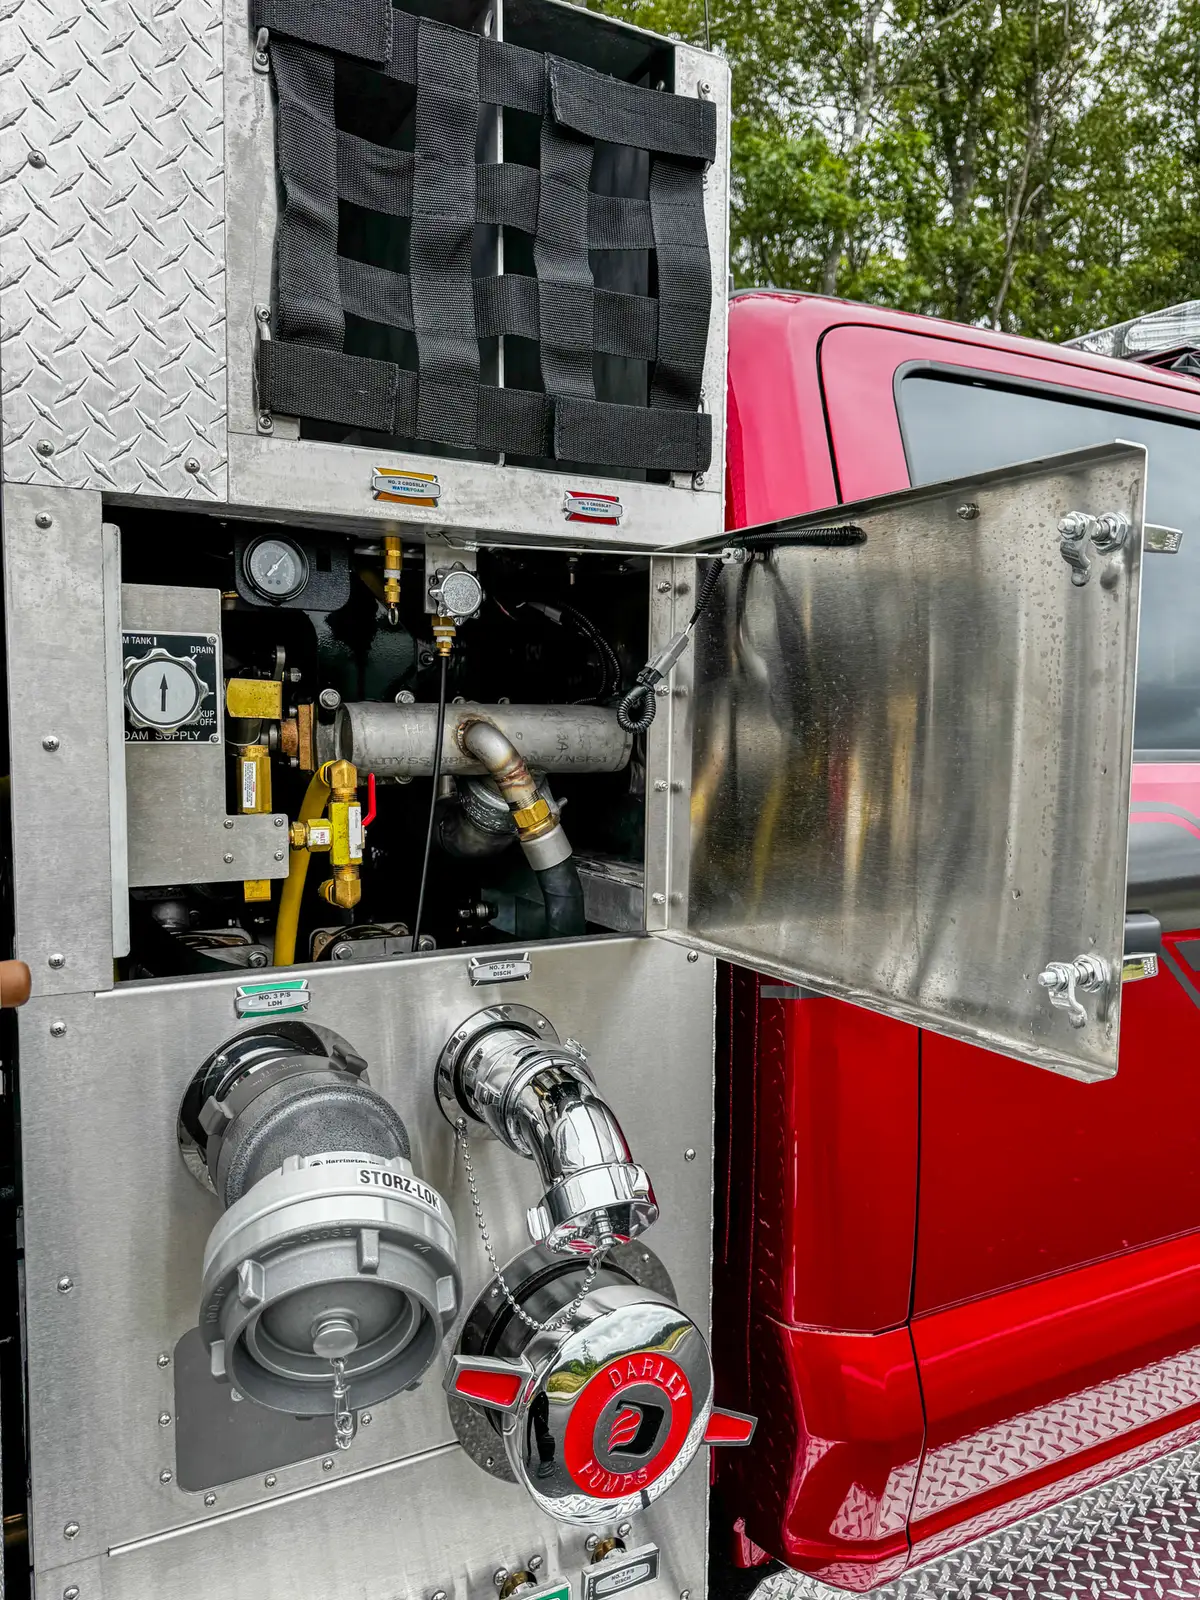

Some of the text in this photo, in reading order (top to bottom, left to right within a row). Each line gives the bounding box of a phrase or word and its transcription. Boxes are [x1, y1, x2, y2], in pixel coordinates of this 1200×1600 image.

[391, 485, 425, 493] WATER/FOAM
[131, 636, 152, 645] TANK
[190, 645, 214, 654] DRAIN
[200, 710, 215, 718] KUP
[200, 718, 214, 726] OFF
[124, 731, 201, 741] OAM SUPPLY
[359, 1169, 440, 1210] STORZ-LOK
[299, 1227, 353, 1244] CLOSE
[608, 1358, 688, 1402] DARLEY
[578, 1459, 649, 1493] PUMPS
[614, 1576, 632, 1585] DISCH
